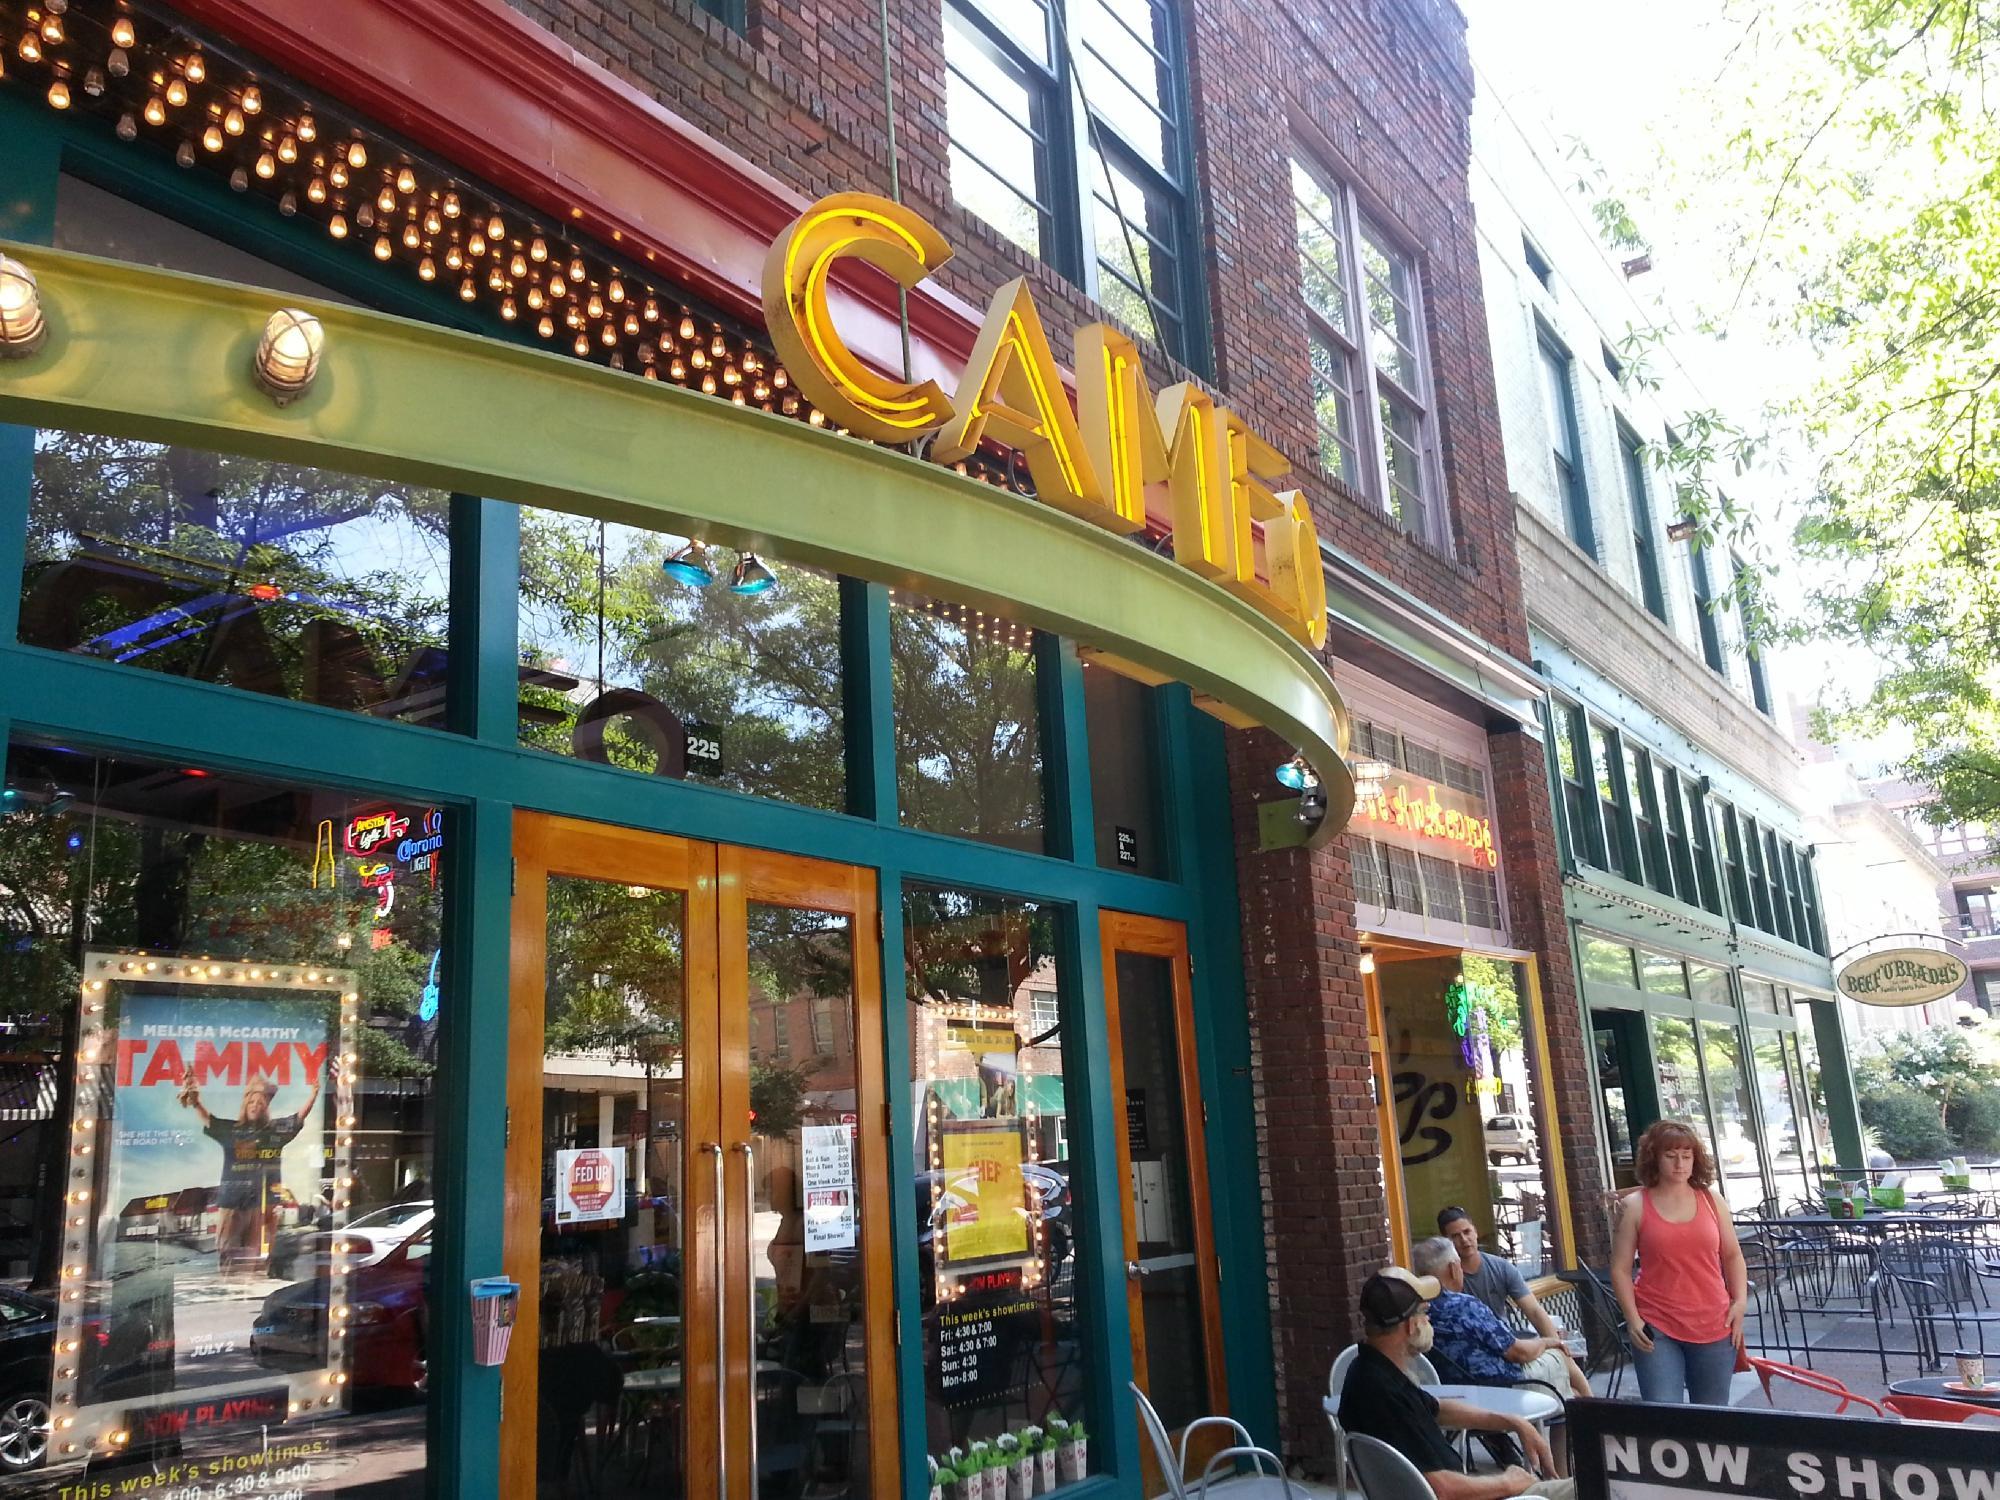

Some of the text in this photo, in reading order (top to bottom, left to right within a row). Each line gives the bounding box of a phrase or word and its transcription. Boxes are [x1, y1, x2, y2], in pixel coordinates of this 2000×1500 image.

[762, 191, 1326, 650] CAMEO
[687, 737, 720, 760] 225
[397, 835, 443, 861] Corona
[143, 1025, 299, 1039] MELISSA McCARTHY
[117, 1040, 329, 1086] TAMMY
[576, 1166, 608, 1182] FED UP
[941, 1300, 1038, 1327] This week's showtimes:
[940, 1321, 992, 1342] Fri: 4:30 & 7:00
[190, 1342, 224, 1357] JULY
[225, 1341, 234, 1352] 2
[941, 1335, 997, 1357] Sat: 4:30 & 7:00
[941, 1354, 977, 1372] Sun: 4:30
[58, 1439, 329, 1500] This week's showtimes:
[1604, 1434, 2000, 1500] NOW SHOW
[215, 1474, 254, 1499] 6:30
[258, 1471, 270, 1489] &
[275, 1463, 311, 1485] 9:00
